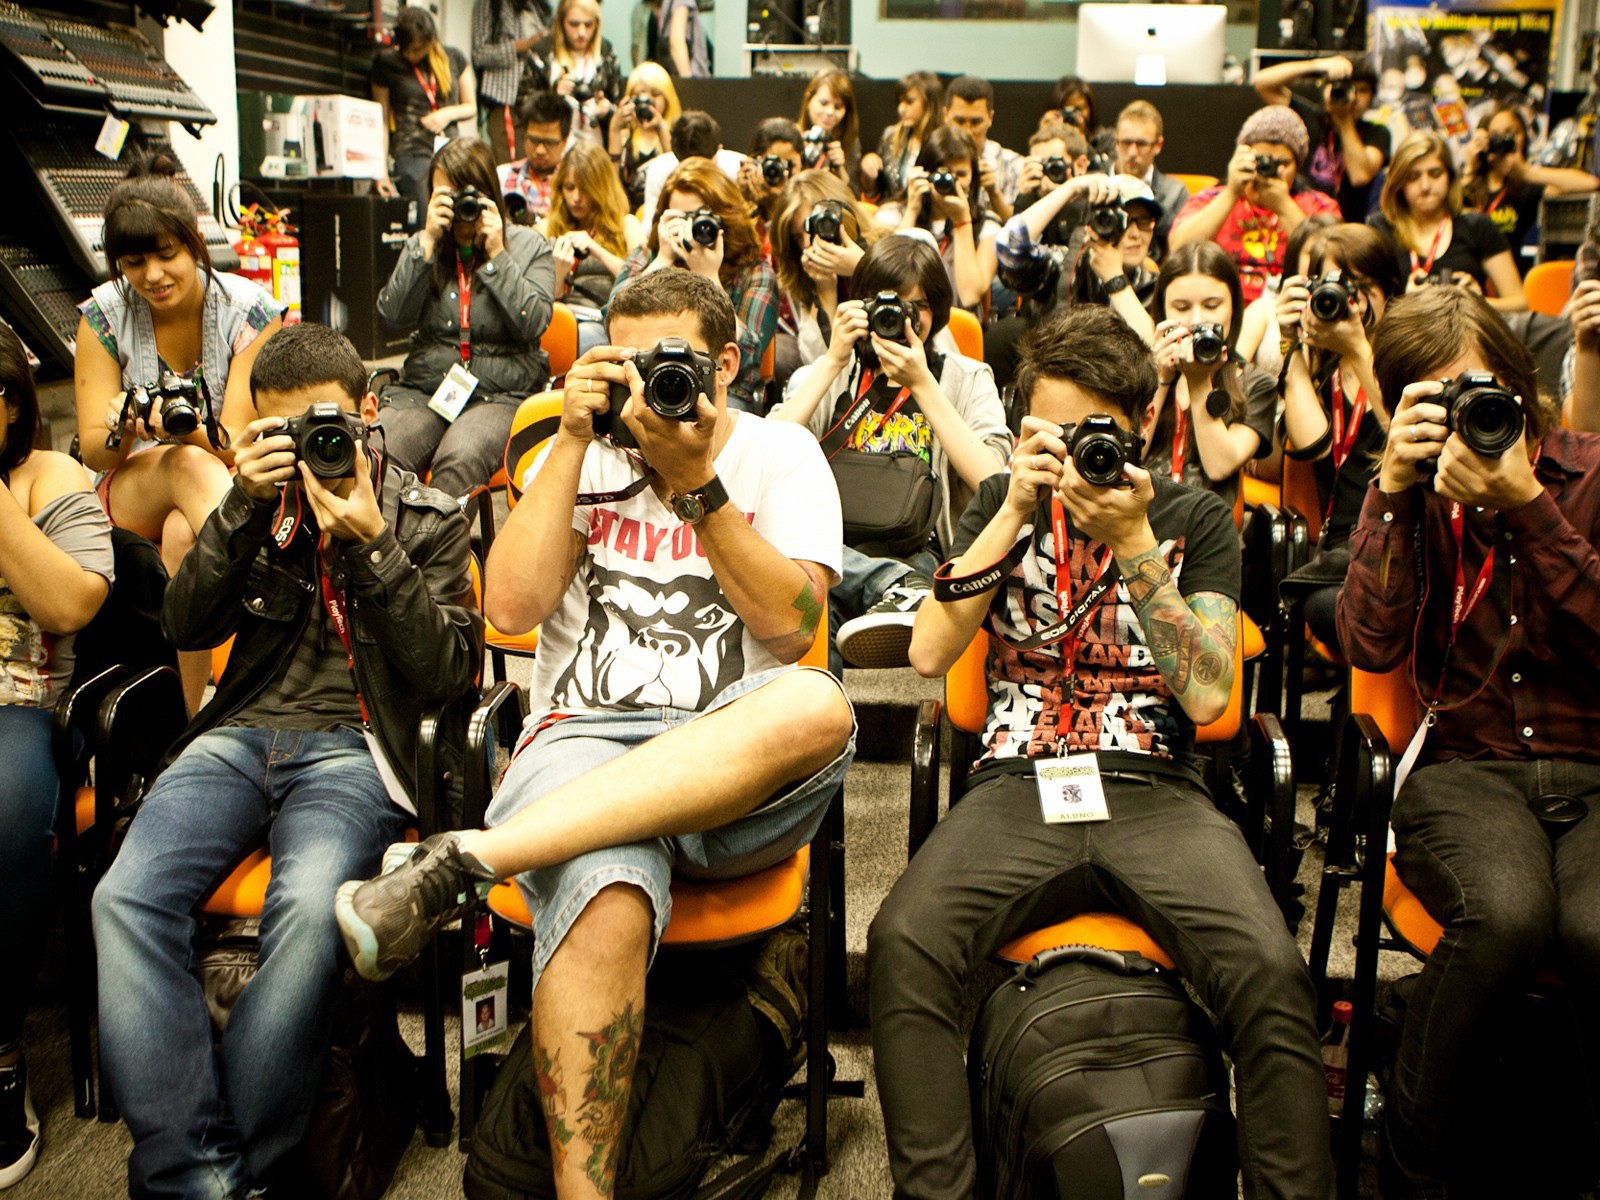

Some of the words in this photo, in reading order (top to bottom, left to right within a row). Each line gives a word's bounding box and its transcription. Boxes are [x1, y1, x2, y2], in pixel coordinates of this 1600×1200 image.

[843, 398, 871, 431] Canon
[274, 516, 295, 542] EOS
[587, 507, 669, 563] STAY
[949, 568, 1002, 595] Canon
[328, 599, 345, 634] PlayTech
[1040, 623, 1069, 641] EOS
[1068, 584, 1108, 626] DIGITAL
[1452, 586, 1464, 624] PlayTech
[1059, 811, 1095, 820] ALUNO
